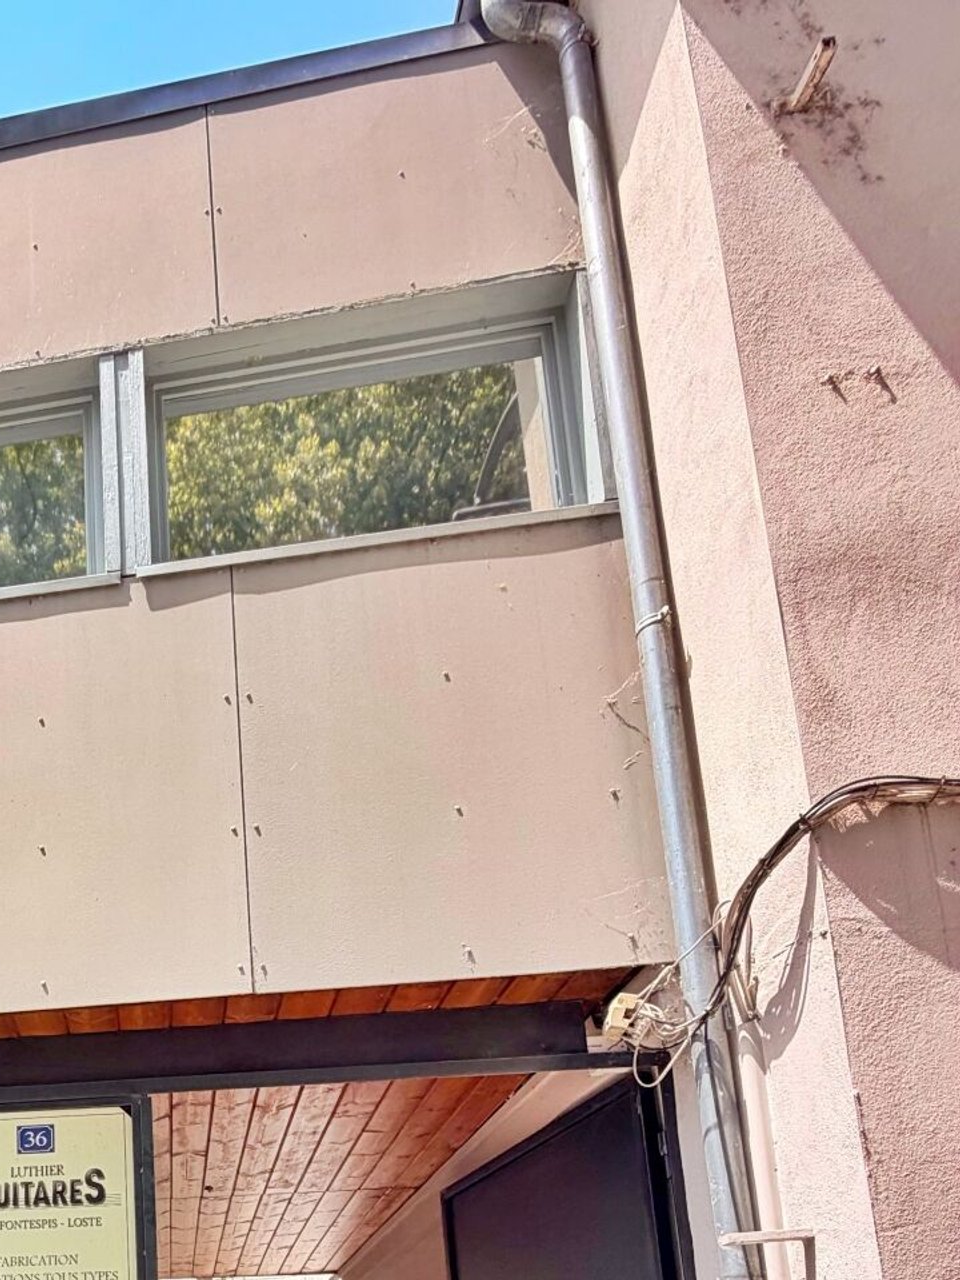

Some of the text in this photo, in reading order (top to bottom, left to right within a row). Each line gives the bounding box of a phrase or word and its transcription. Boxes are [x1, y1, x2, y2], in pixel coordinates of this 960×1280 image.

[24, 1130, 47, 1147] 36
[11, 1164, 65, 1178] LUTHIER
[0, 1218, 58, 1230] FONTESPIS
[68, 1216, 102, 1228] LOSTE
